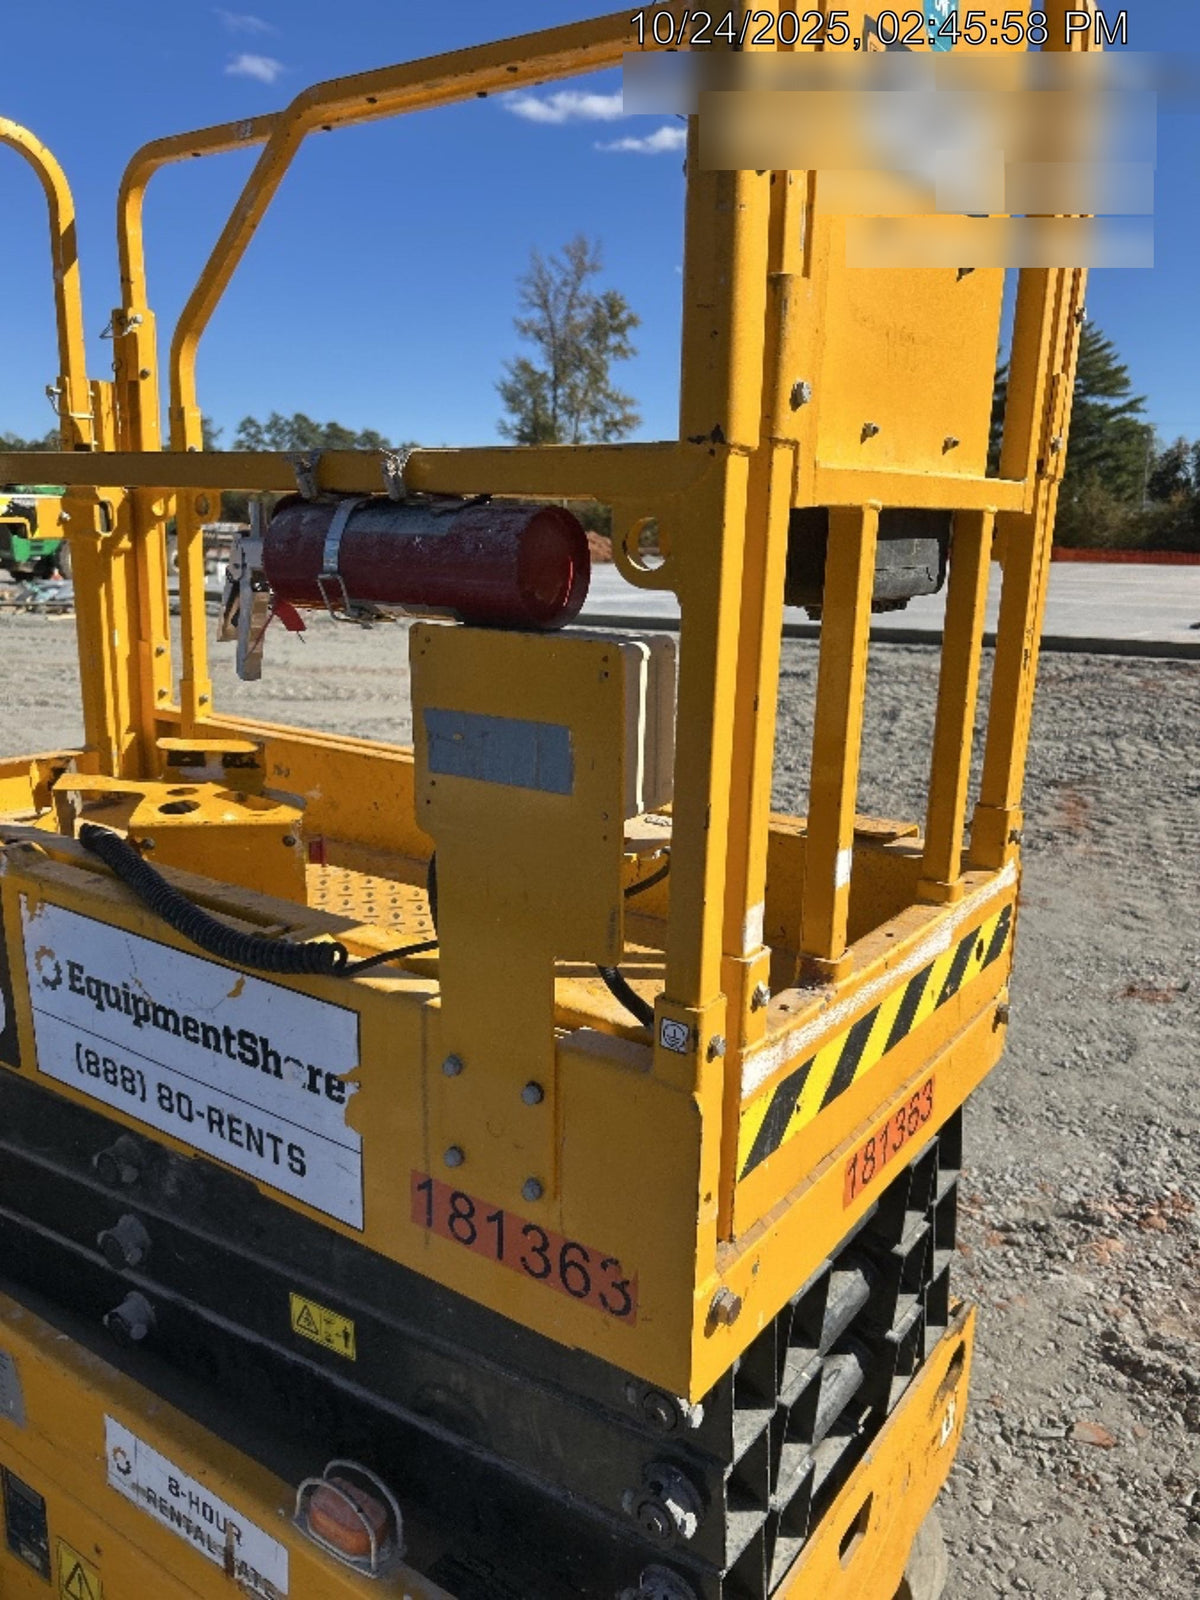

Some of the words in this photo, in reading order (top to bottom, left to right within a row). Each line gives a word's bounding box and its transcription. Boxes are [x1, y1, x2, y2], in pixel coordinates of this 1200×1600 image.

[75, 1041, 147, 1103] (888)
[157, 1081, 306, 1179] 80-RENTS
[846, 1077, 934, 1200] 181363
[417, 1178, 633, 1318] 181363
